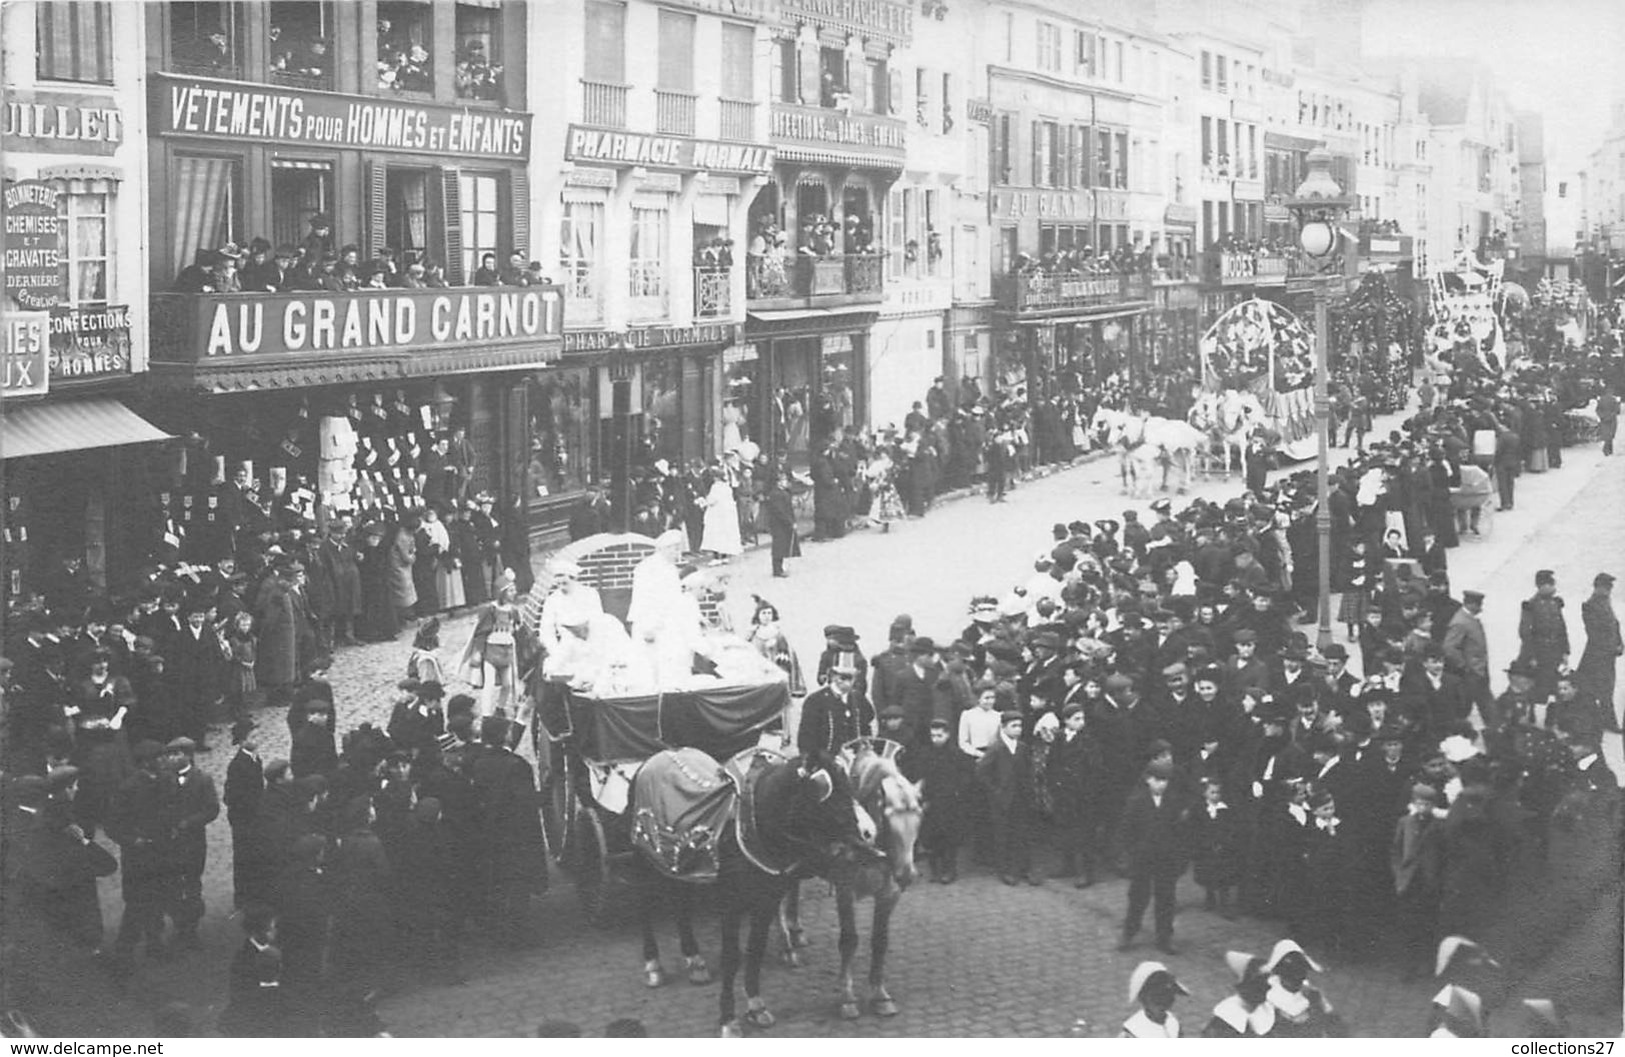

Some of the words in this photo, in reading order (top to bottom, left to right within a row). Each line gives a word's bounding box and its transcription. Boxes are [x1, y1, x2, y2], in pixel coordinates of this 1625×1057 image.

[172, 84, 304, 139] VÊTEMENTS
[305, 114, 343, 142] POUR
[346, 103, 427, 149] HOMMES
[429, 126, 446, 149] ET
[448, 111, 523, 154] ENFANTS
[571, 128, 682, 166] PHARMACIE
[4, 184, 59, 209] BONNETERIE
[6, 215, 57, 233] CHEMISES
[23, 237, 40, 246] ET
[6, 249, 58, 268] CRAVATES
[48, 311, 133, 335] CONFECTIONS
[208, 303, 264, 355] AU
[283, 296, 417, 350] GRAND
[432, 291, 560, 341] CARNOT
[662, 325, 728, 345] NORMALE
[61, 353, 122, 376] HOMMES
